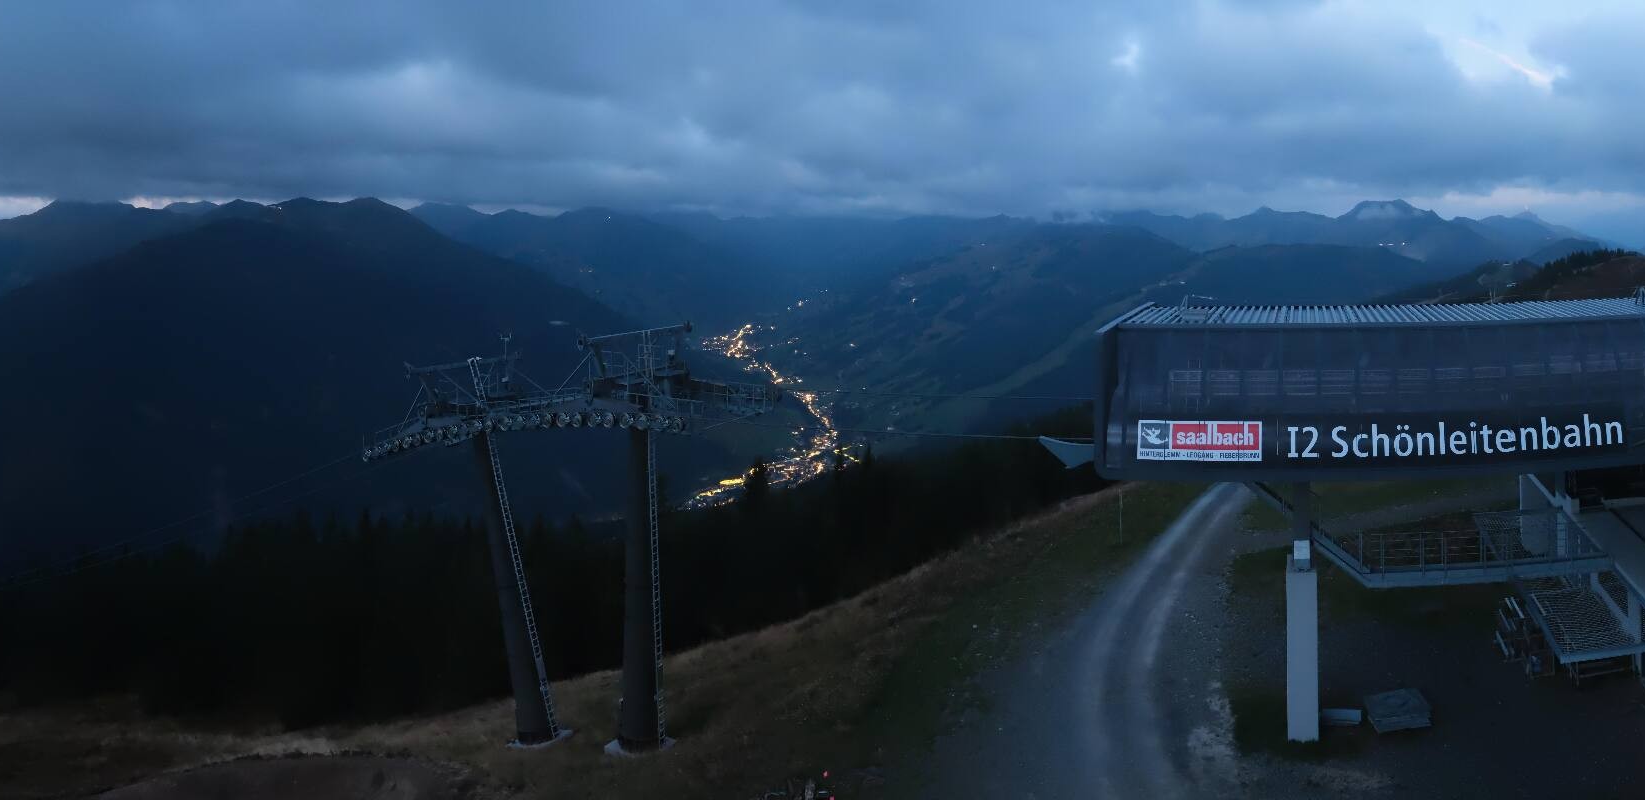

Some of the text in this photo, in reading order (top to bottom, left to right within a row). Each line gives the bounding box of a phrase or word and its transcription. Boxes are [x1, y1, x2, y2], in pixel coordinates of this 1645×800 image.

[1176, 423, 1254, 446] saalbach
[1287, 413, 1623, 458] I2 Schönleitenbahn
